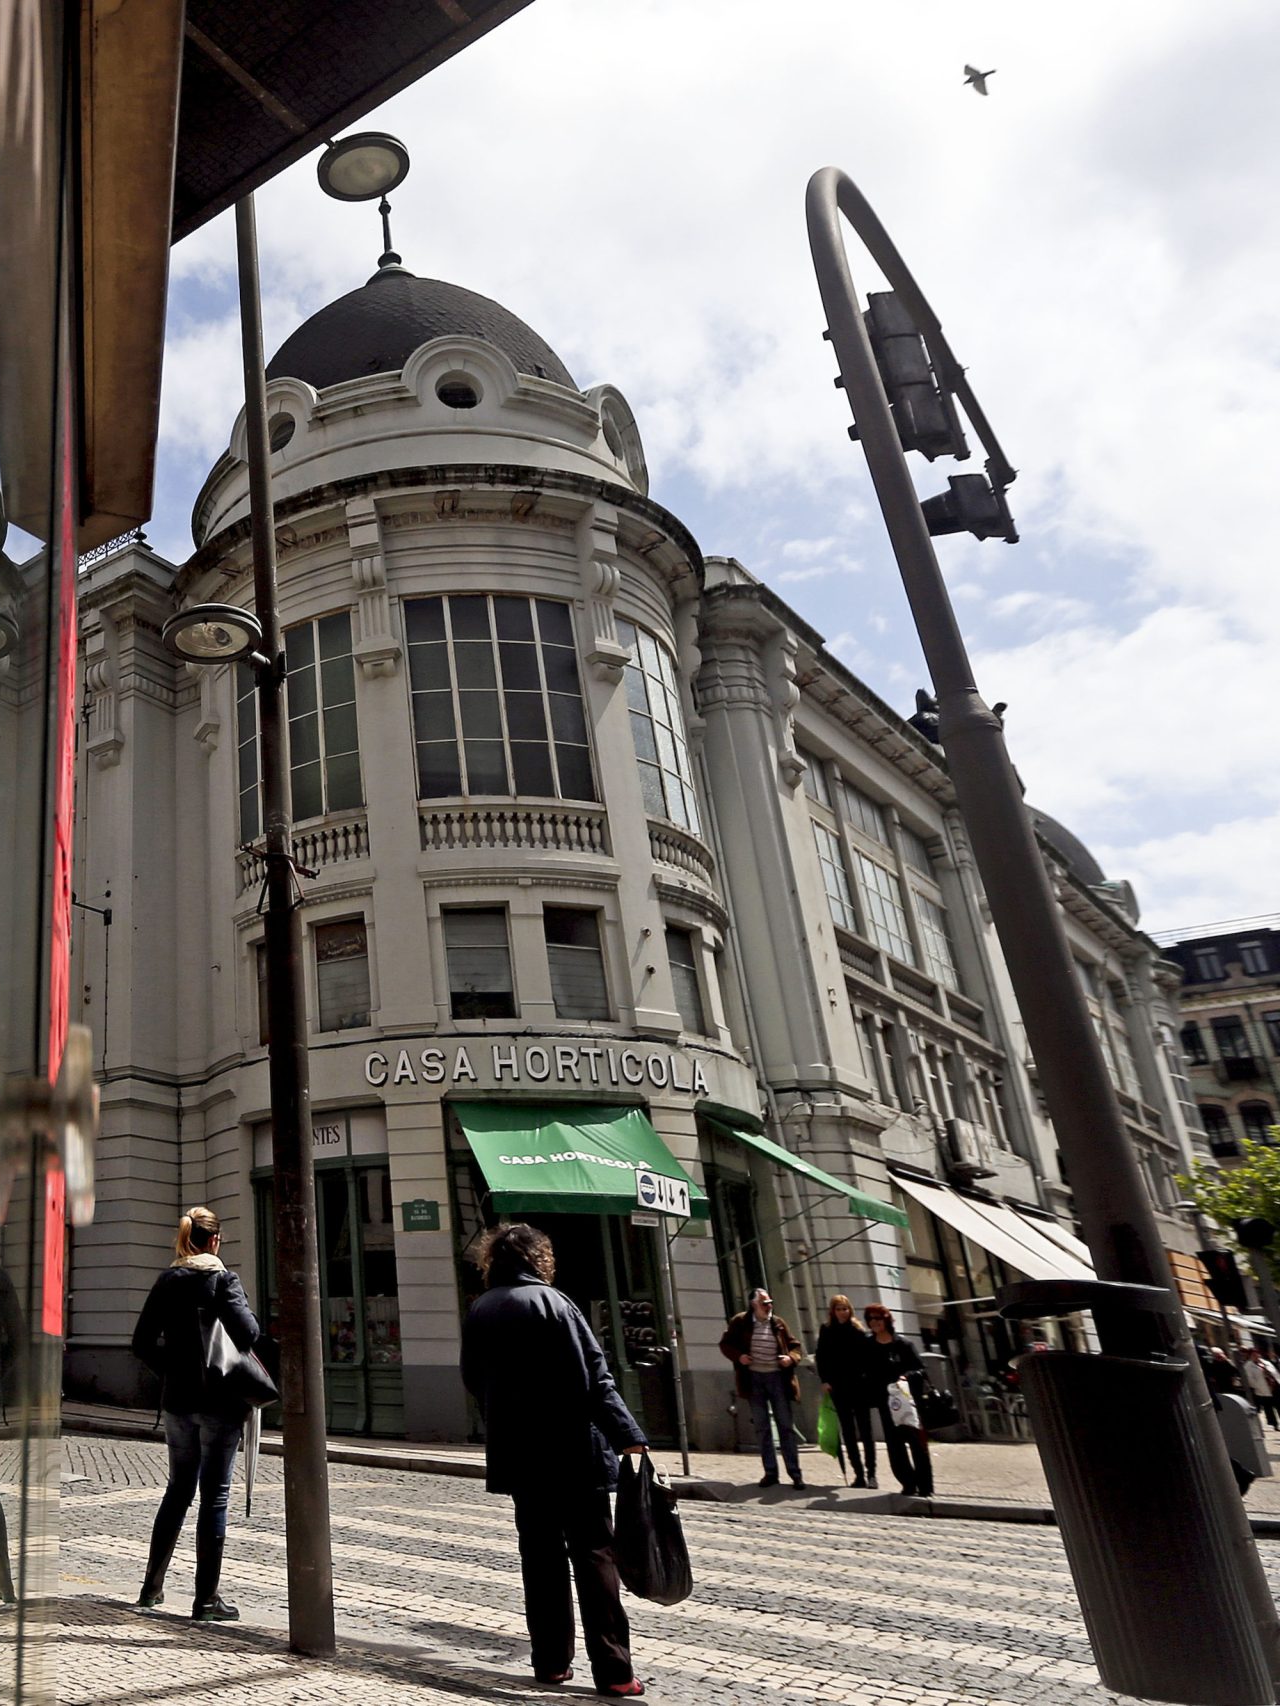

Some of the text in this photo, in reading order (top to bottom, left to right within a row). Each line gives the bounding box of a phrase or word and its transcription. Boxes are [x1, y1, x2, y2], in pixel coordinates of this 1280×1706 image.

[365, 1045, 710, 1094] CASA HORTICOLA
[499, 1151, 653, 1170] CASA HORTICOLA
